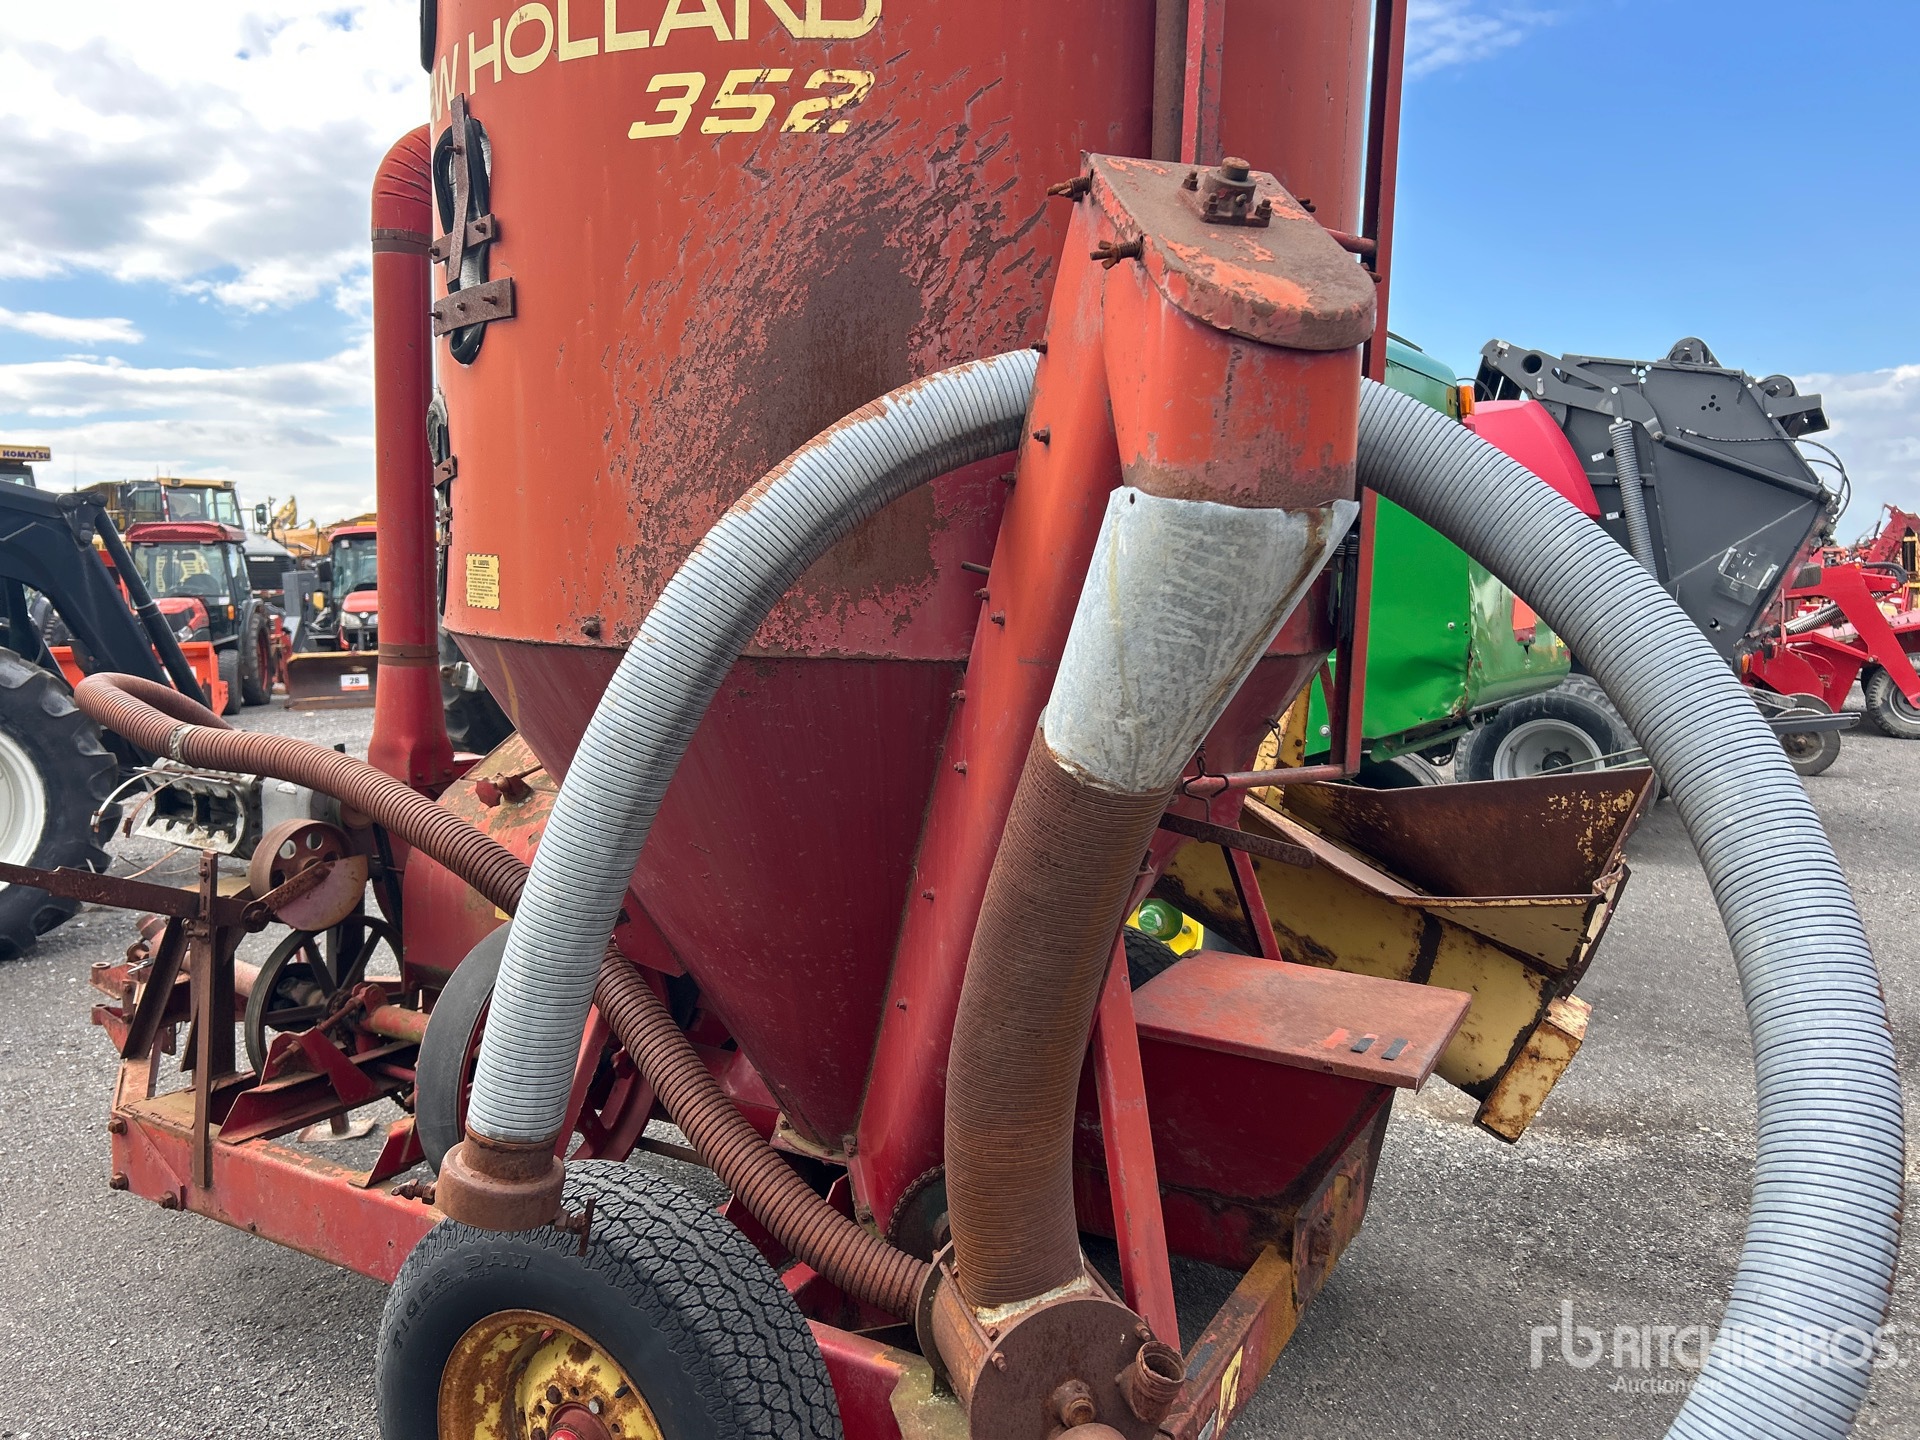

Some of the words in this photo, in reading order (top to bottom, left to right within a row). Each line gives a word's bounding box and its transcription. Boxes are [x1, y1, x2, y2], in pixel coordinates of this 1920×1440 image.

[628, 69, 875, 140] 352
[2, 450, 50, 459] KOMATSU
[349, 677, 360, 685] 28
